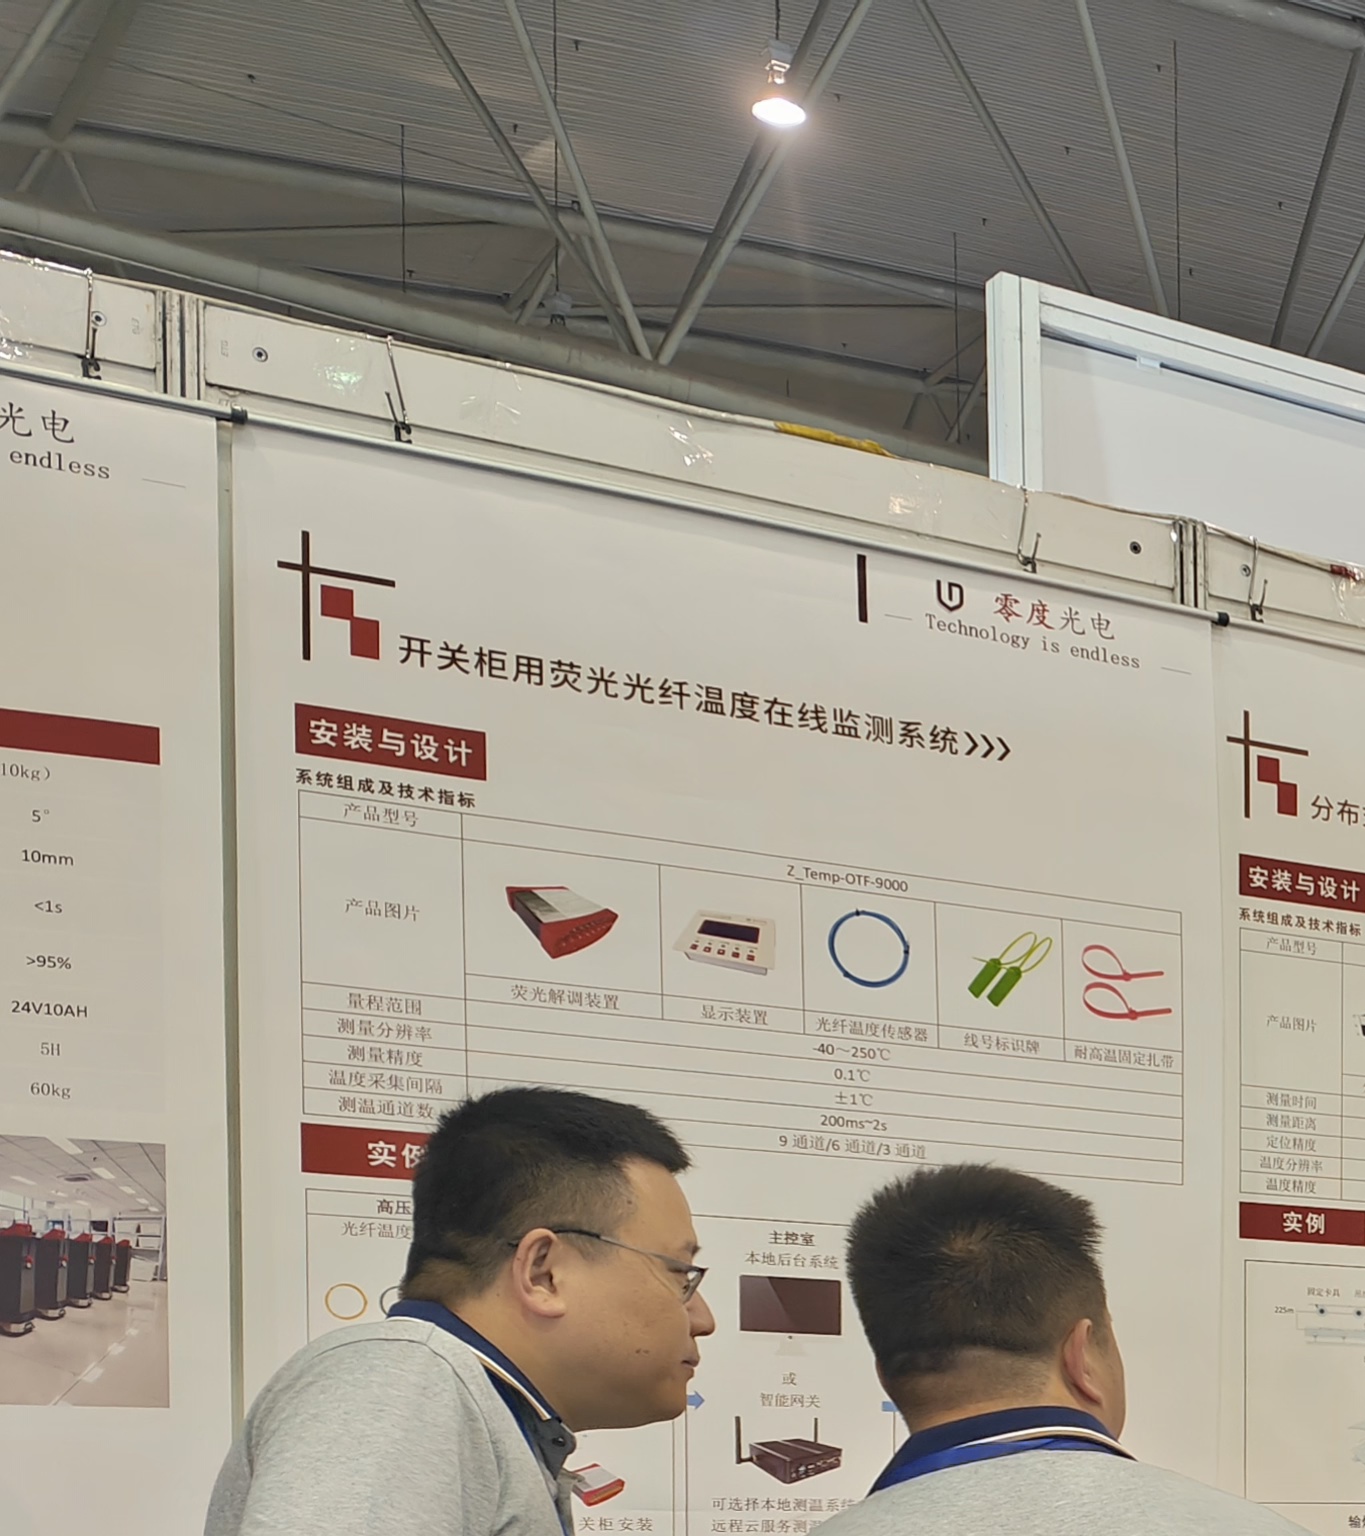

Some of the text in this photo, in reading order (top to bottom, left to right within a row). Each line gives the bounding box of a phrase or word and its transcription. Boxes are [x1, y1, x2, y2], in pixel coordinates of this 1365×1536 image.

[0, 401, 75, 444] 光电
[9, 449, 110, 480] endless
[993, 592, 1117, 641] 零度光电
[924, 612, 1141, 670] Technology is endless
[398, 634, 960, 757] 开关柜用荧光光纤温度在线监测系统
[308, 718, 475, 768] 安装与设计
[295, 767, 477, 810] 系统组成及技术指标
[342, 802, 419, 829] 产品型号
[20, 848, 74, 867] 10mm
[785, 864, 910, 894] Z_Temp-OTF-9000
[1247, 865, 1361, 904] 安装与设计
[33, 900, 64, 915] <1s
[344, 897, 421, 922] 产品图片
[1238, 906, 1363, 938] 系统组成及技术指标
[1265, 935, 1318, 957] 产品型号
[25, 954, 73, 971] >95%
[347, 991, 423, 1016] 量程范围
[510, 983, 621, 1011] 荧光解调装置
[10, 1000, 89, 1019] 24V10AH
[699, 1003, 770, 1026] 显示装置
[336, 1017, 433, 1042] 测量分辨率
[815, 1016, 929, 1044] 光纤温度传感器
[1265, 1014, 1318, 1033] 产品图片
[39, 1042, 62, 1058] 5H
[962, 1031, 1041, 1055] 线号标识牌
[346, 1044, 423, 1068] 测量精度
[1073, 1044, 1175, 1070] 耐高温固定扎带
[29, 1081, 73, 1100] 60kg
[328, 1068, 444, 1095] 温度采集间隔
[338, 1095, 435, 1120] 测温通道数
[1265, 1090, 1318, 1111] 测量时间
[1265, 1112, 1318, 1132] 测量距离
[778, 1134, 788, 1148] 9
[1265, 1134, 1318, 1154] 定位精度
[1259, 1154, 1324, 1174] 温度分辨率
[1265, 1176, 1318, 1196] 温度精度
[341, 1220, 413, 1241] 光纤温度
[1281, 1211, 1327, 1236] 实例
[768, 1229, 816, 1247] 主控室
[744, 1250, 840, 1271] 本地后台系统
[782, 1372, 797, 1386] 或
[760, 1392, 822, 1409] 智能网关
